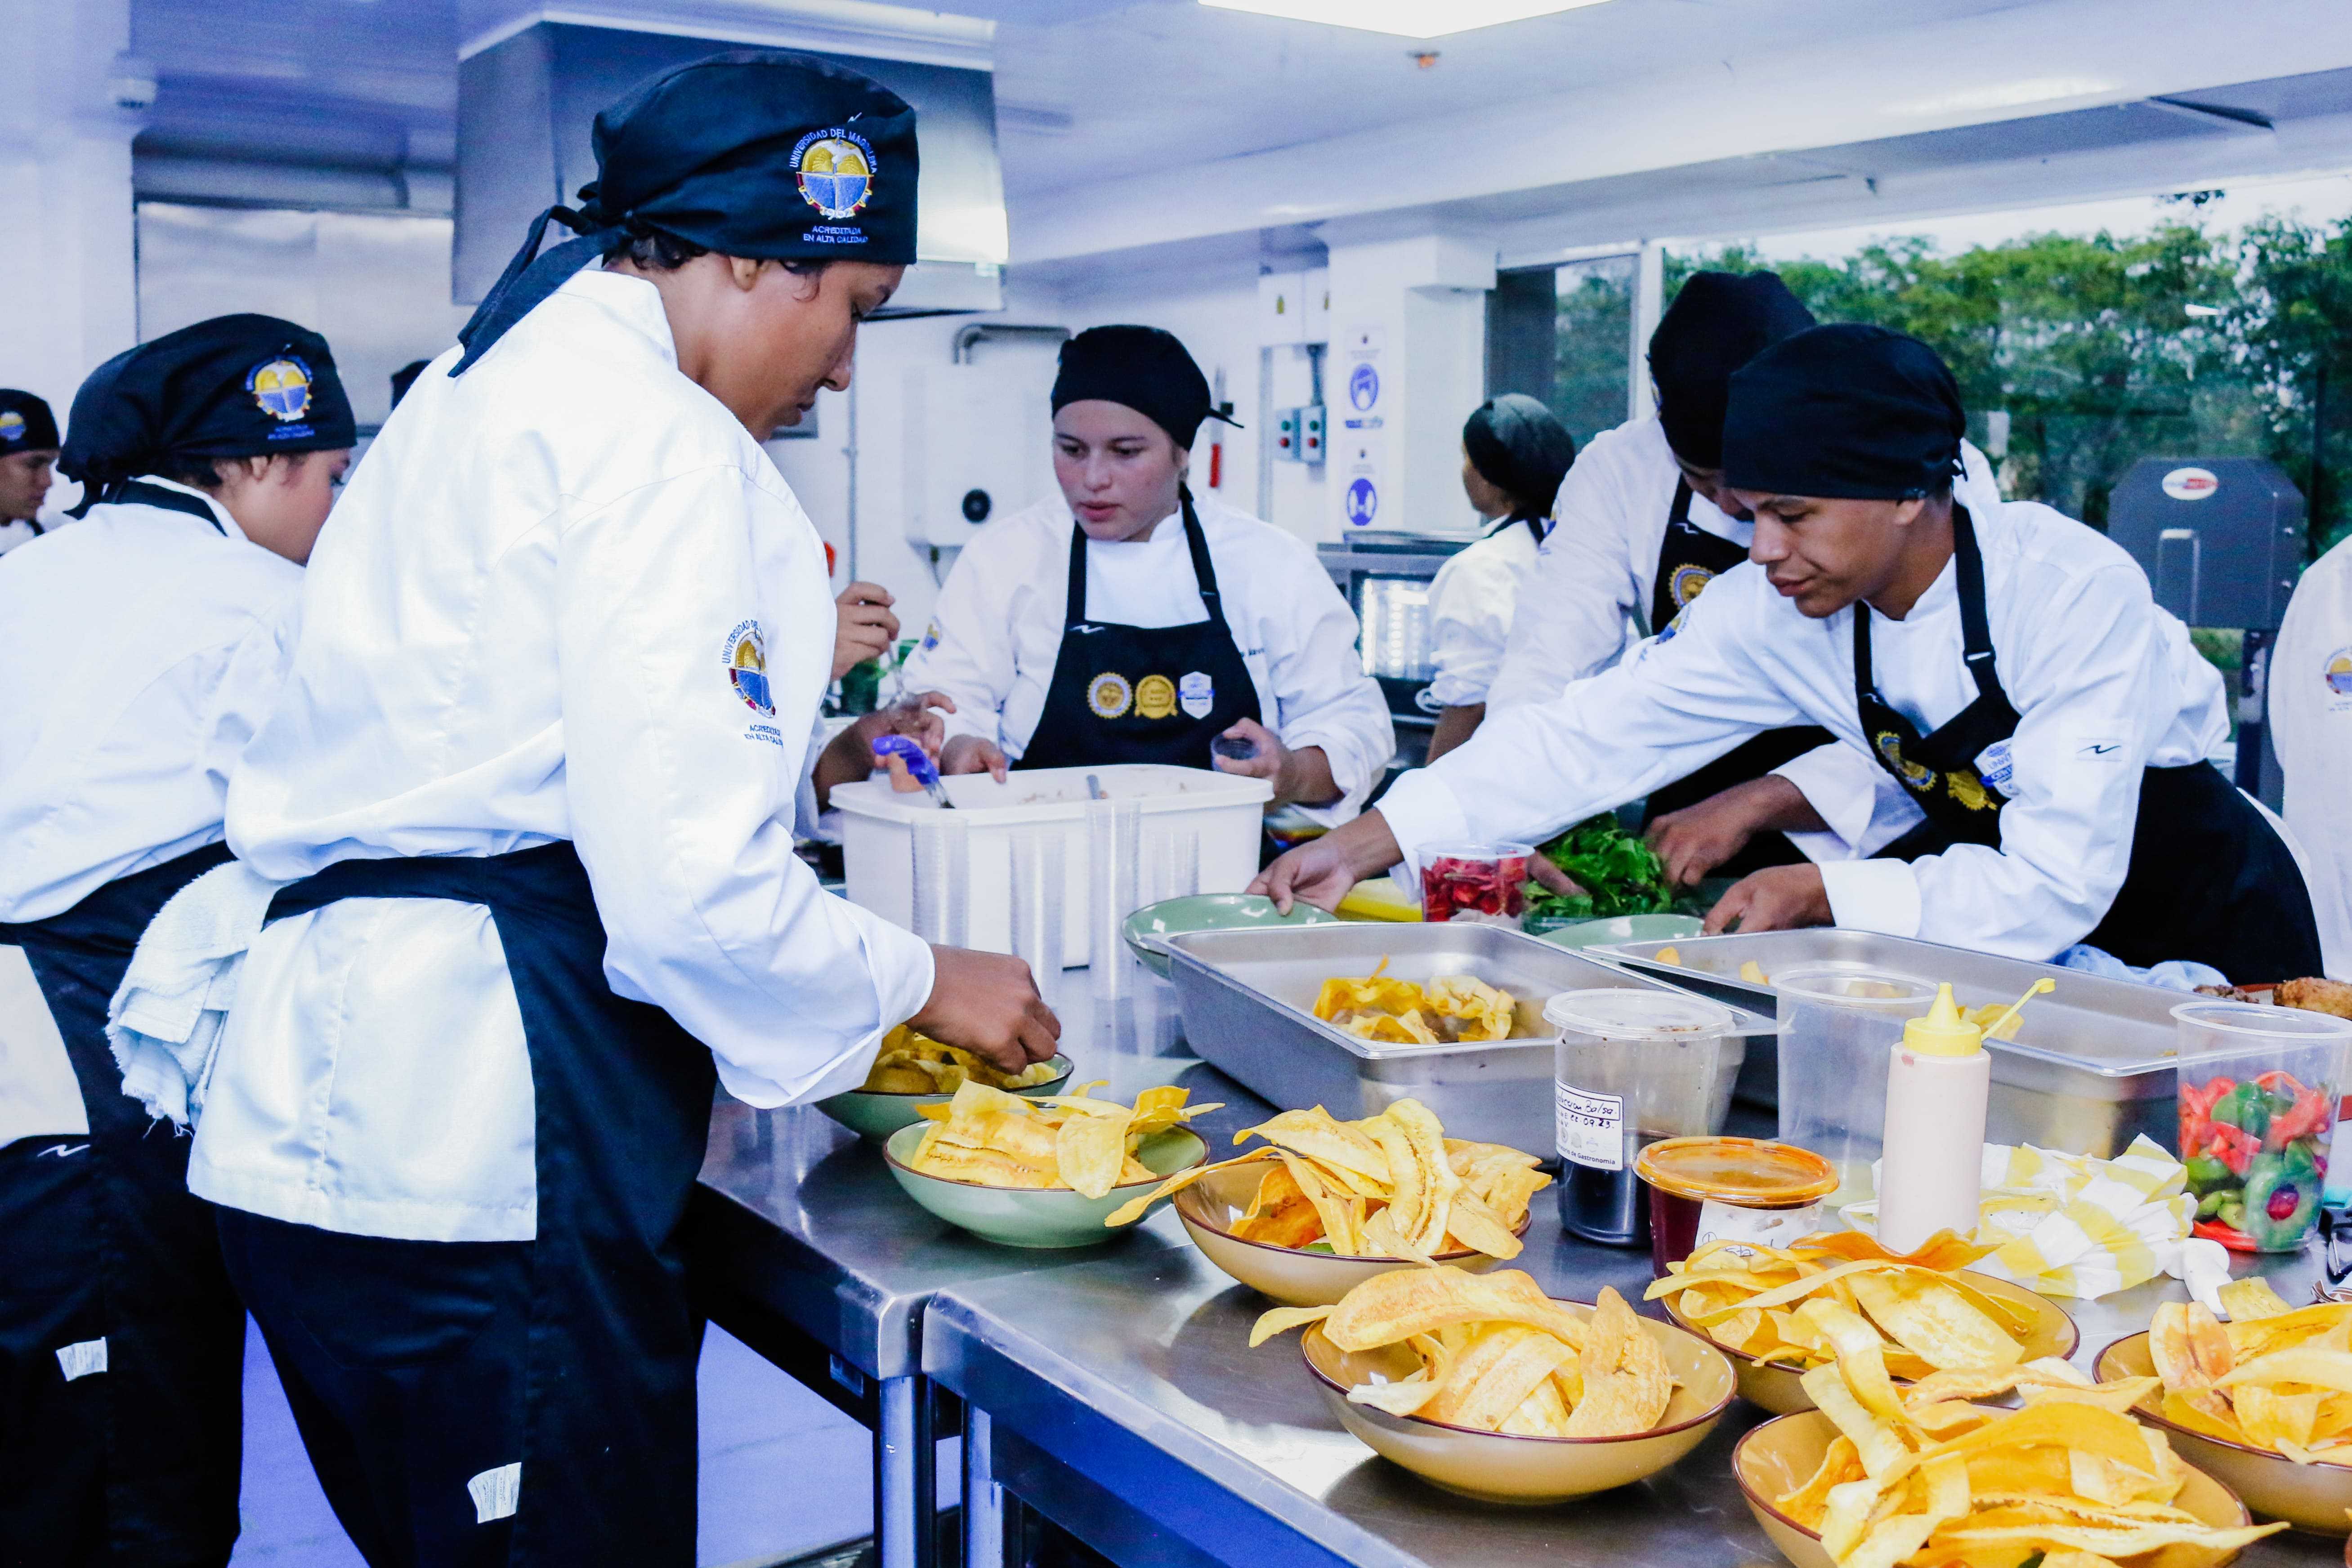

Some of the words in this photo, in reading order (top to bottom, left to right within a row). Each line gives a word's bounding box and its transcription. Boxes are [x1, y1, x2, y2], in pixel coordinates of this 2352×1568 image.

[789, 130, 828, 168] UNIVERSIDAD
[830, 128, 846, 138] DEL
[803, 233, 814, 241] EN
[816, 235, 835, 243] ALTA
[812, 226, 861, 234] ACREDITADA
[722, 620, 750, 663] UNIVERSIDAD
